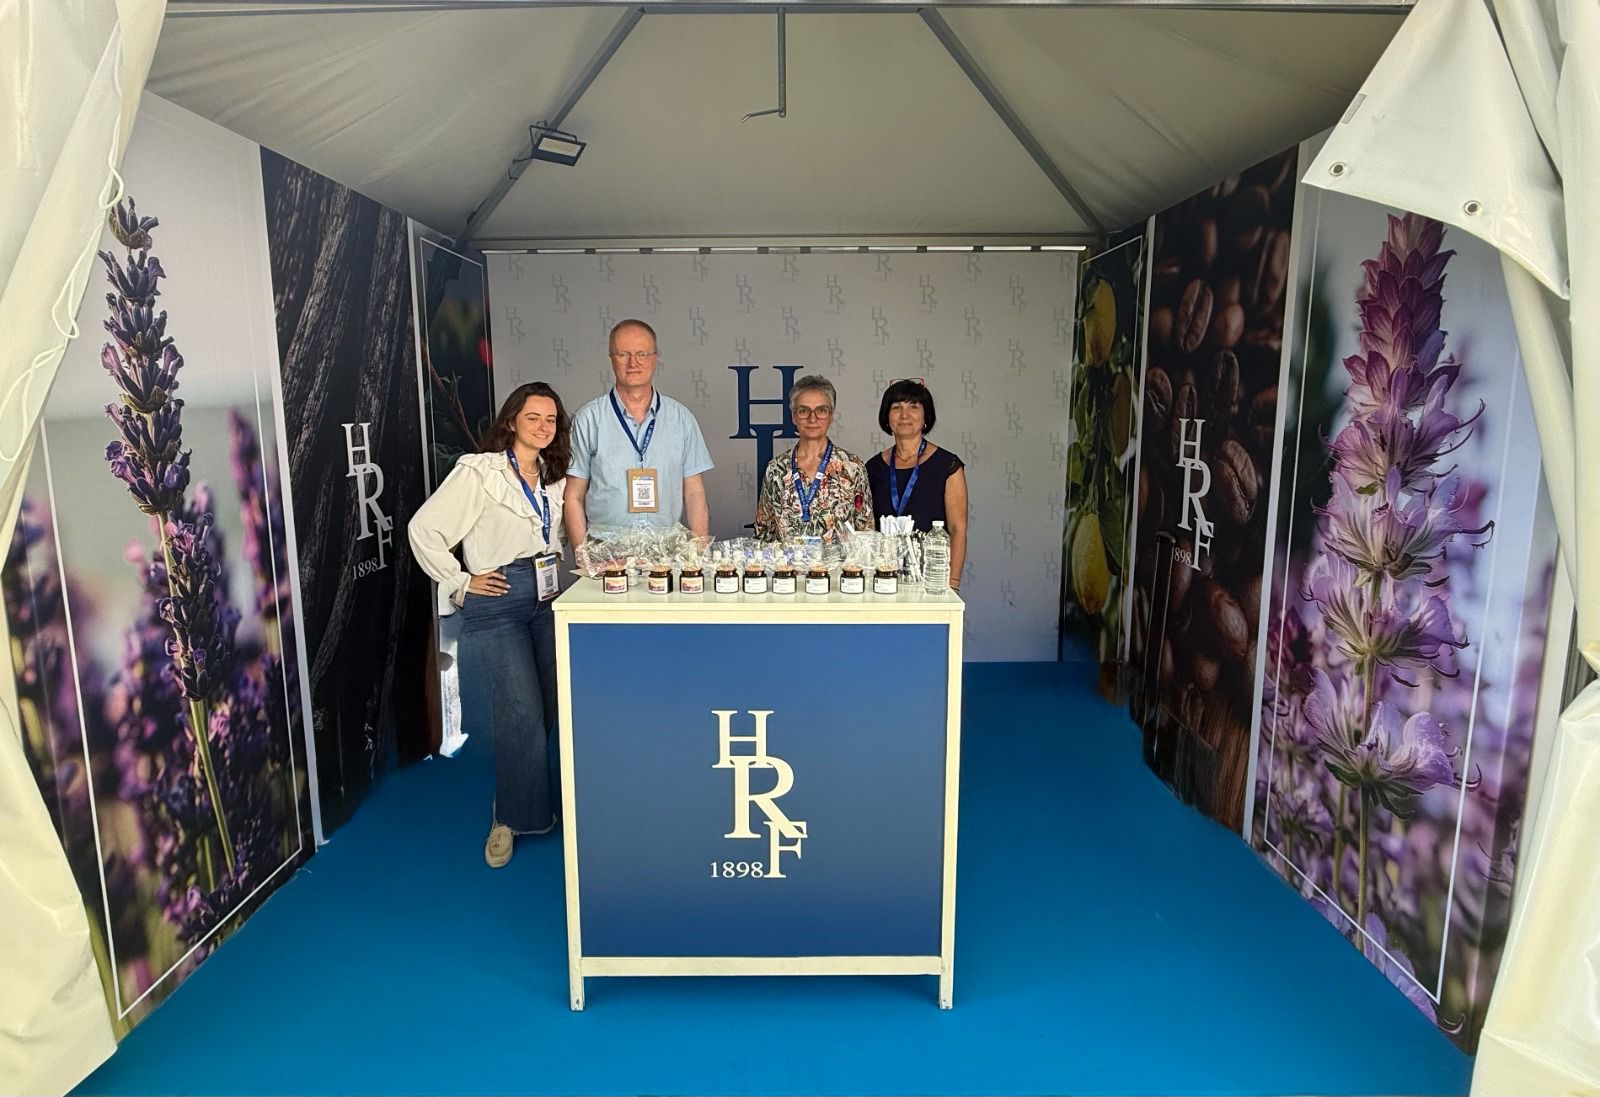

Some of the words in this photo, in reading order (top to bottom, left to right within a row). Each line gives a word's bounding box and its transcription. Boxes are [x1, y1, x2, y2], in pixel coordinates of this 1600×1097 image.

[352, 556, 379, 580] 1898
[1175, 547, 1192, 567] 898
[711, 709, 808, 879] HRF
[710, 861, 763, 879] 1898
